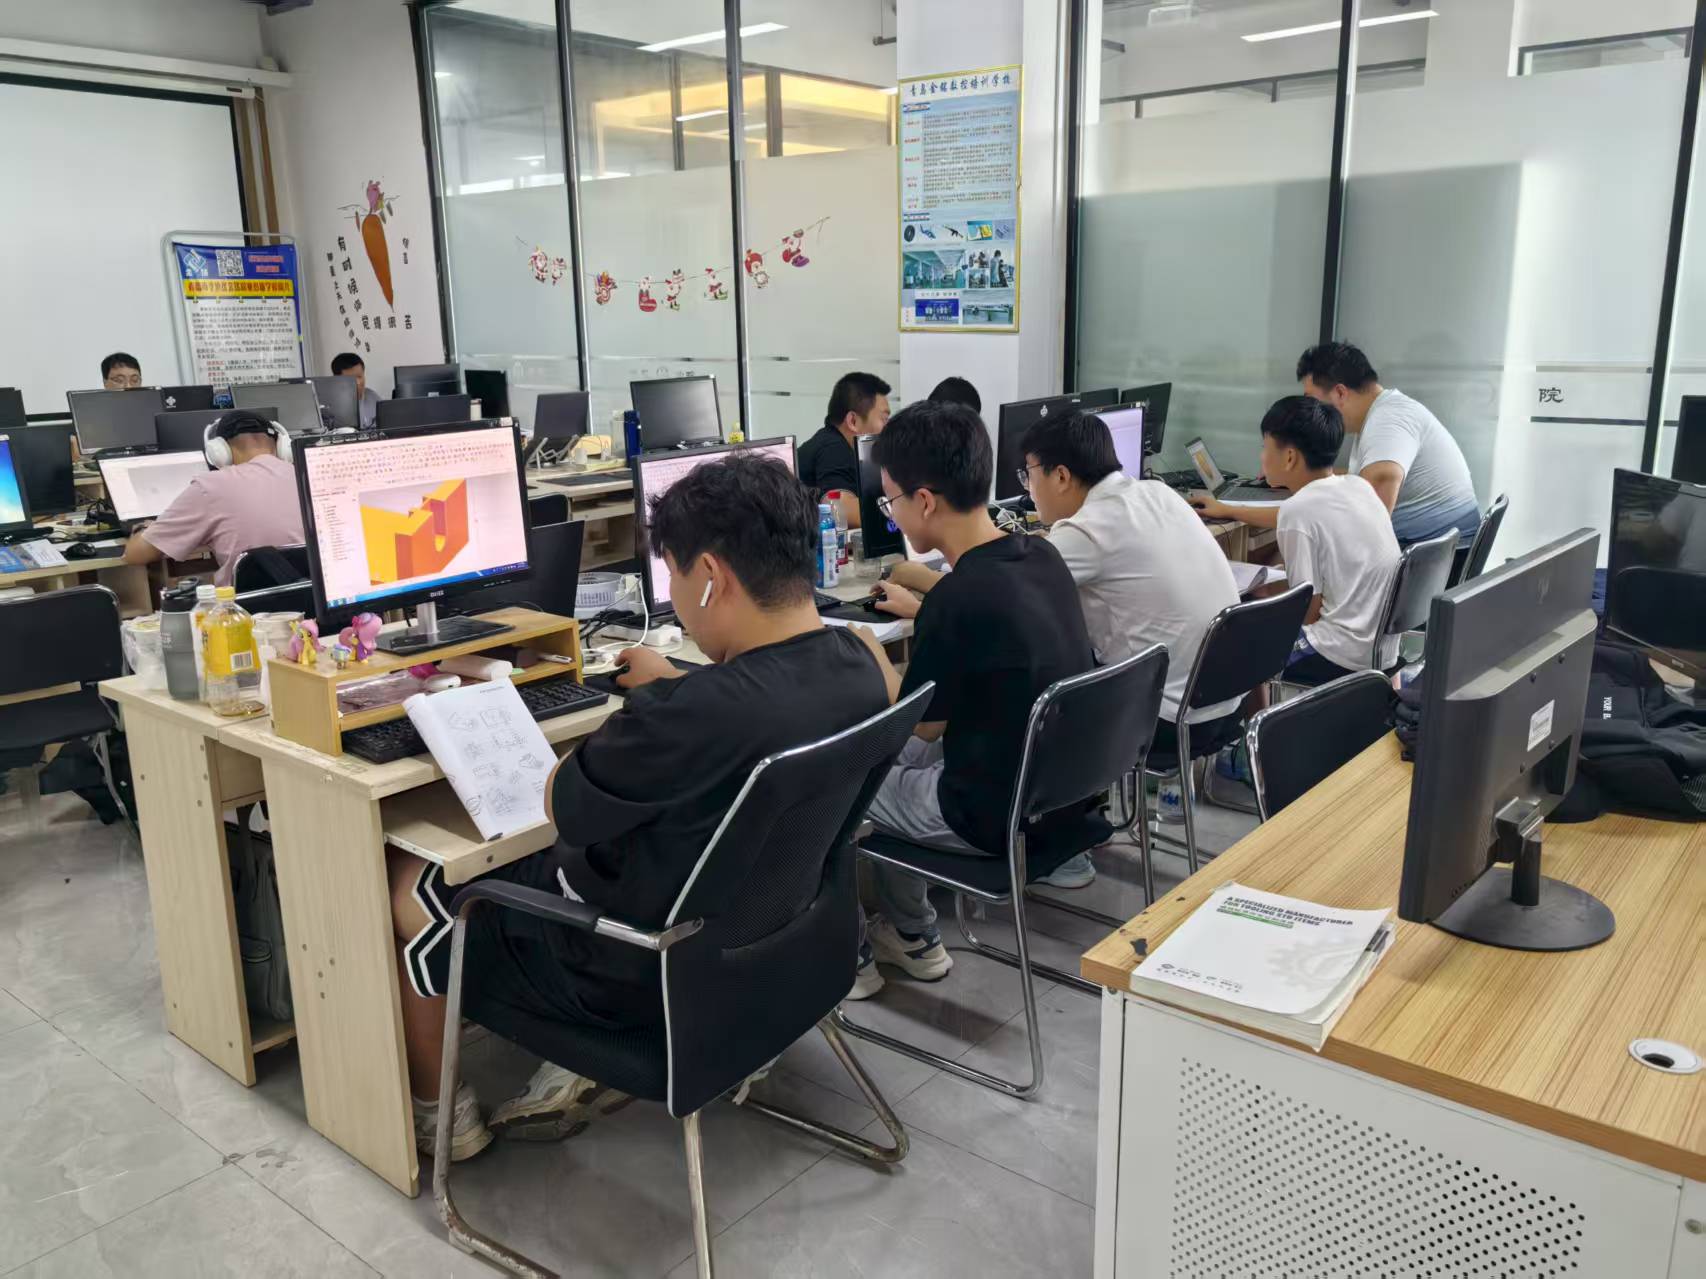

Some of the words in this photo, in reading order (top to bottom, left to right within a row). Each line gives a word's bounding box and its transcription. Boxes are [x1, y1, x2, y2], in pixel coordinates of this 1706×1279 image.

[1538, 387, 1564, 403] 院
[1234, 897, 1284, 912] SPECIALIZED
[1285, 910, 1353, 925] MANUFACTURER
[1241, 903, 1275, 916] TOOLING
[1294, 916, 1320, 926] ITEMS
